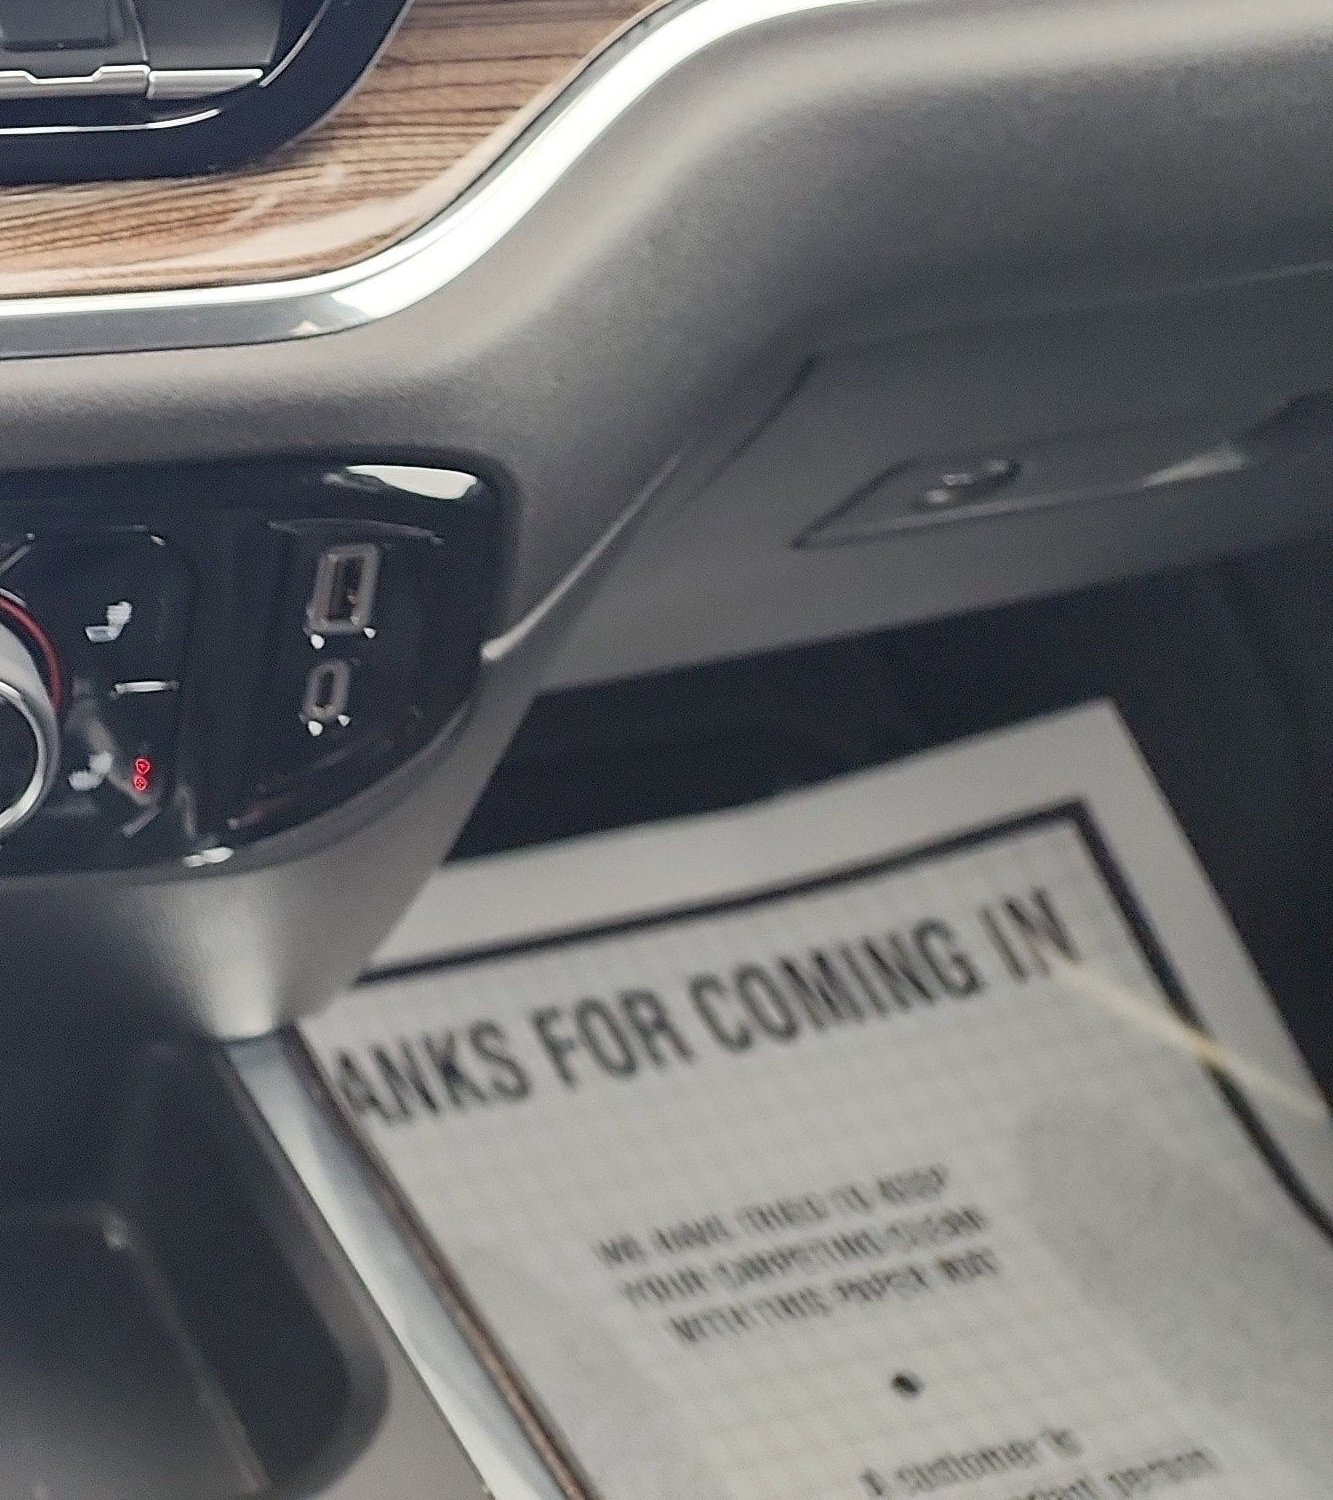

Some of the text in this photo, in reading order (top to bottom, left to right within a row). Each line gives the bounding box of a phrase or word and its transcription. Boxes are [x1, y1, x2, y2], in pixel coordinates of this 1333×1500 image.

[334, 885, 1084, 1128] ANKS FOR COMING IN
